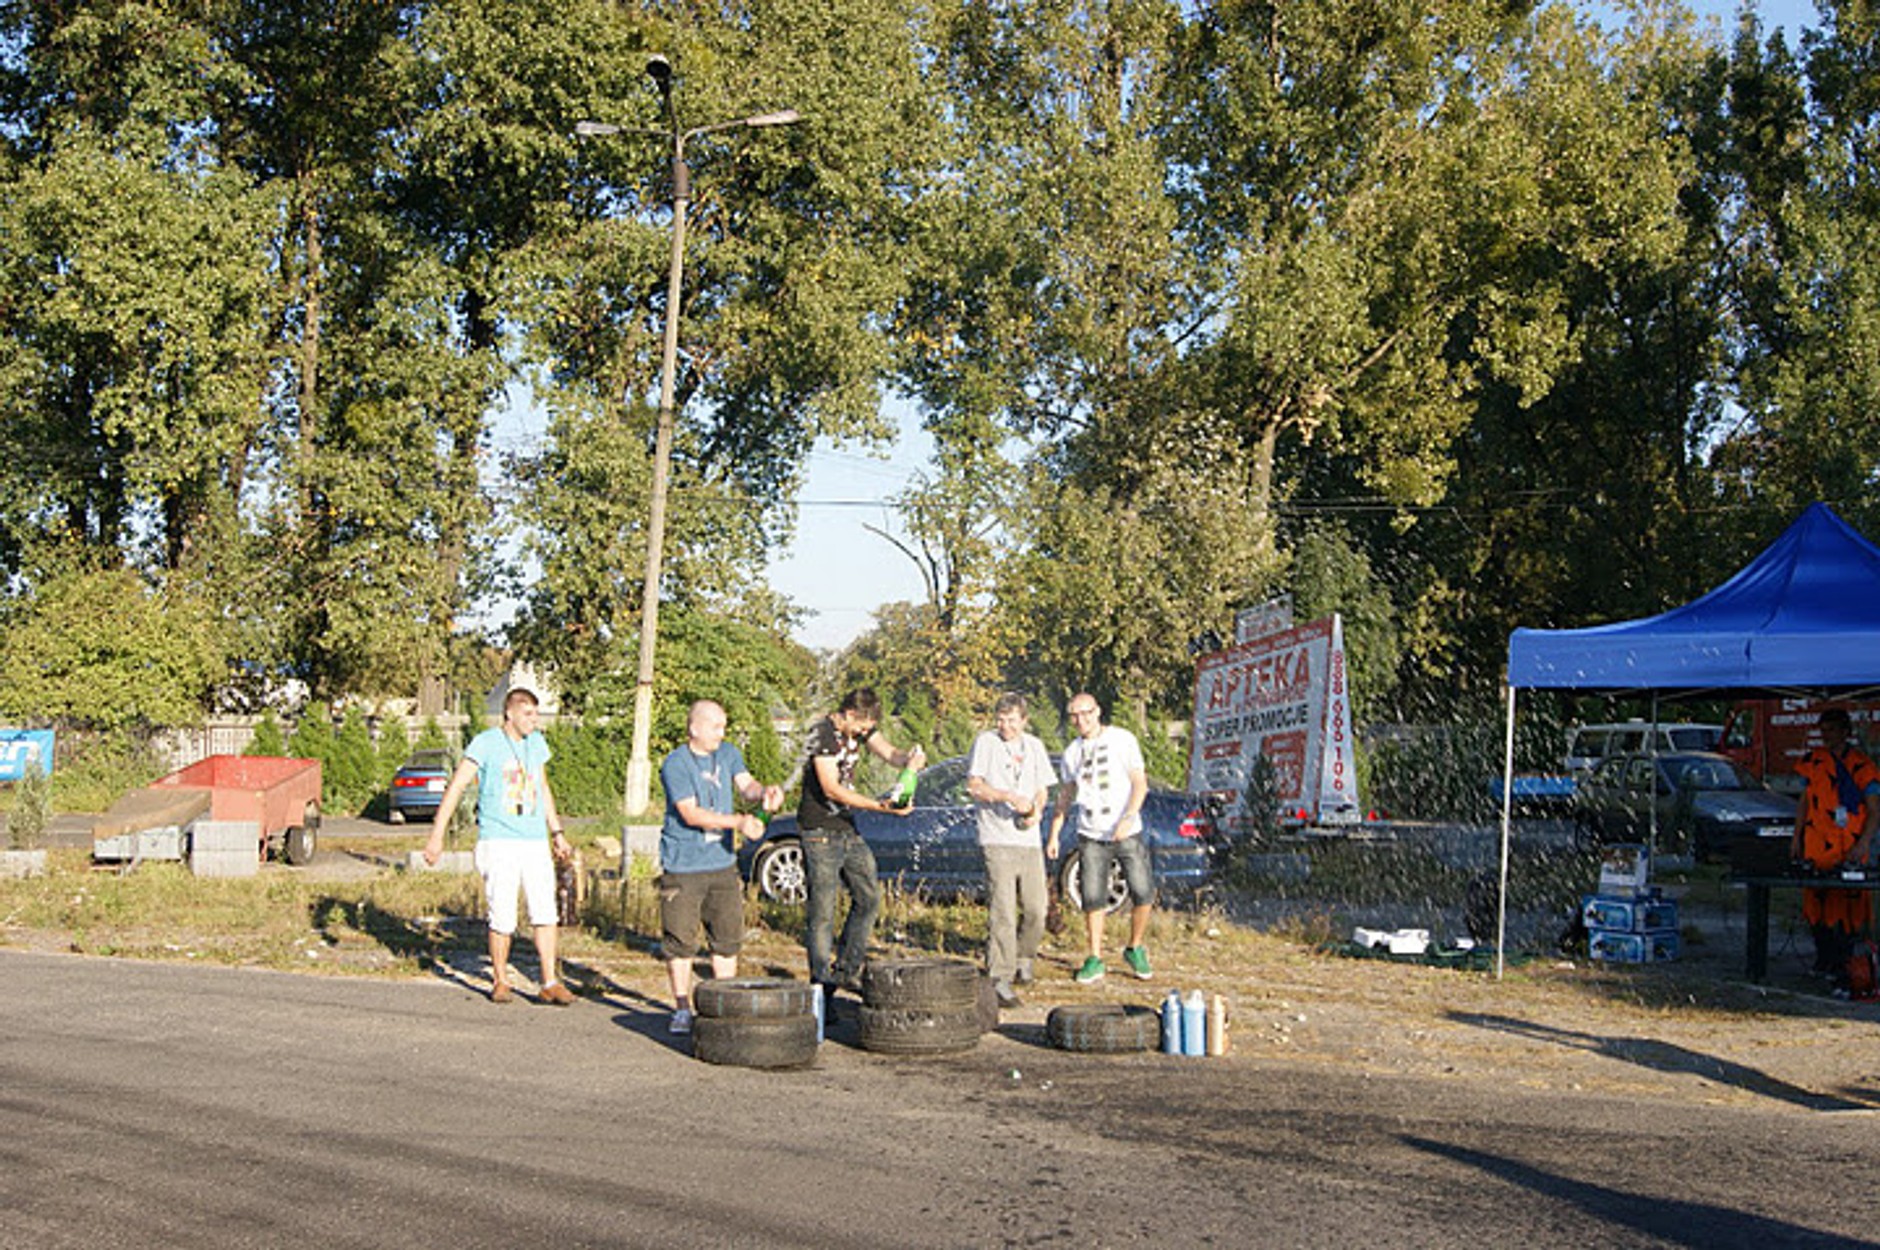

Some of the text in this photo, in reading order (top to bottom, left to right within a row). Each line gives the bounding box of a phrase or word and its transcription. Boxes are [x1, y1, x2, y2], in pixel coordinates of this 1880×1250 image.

[1208, 647, 1309, 710] APTEKA
[1205, 703, 1308, 742] SUPER PROMOCJE
